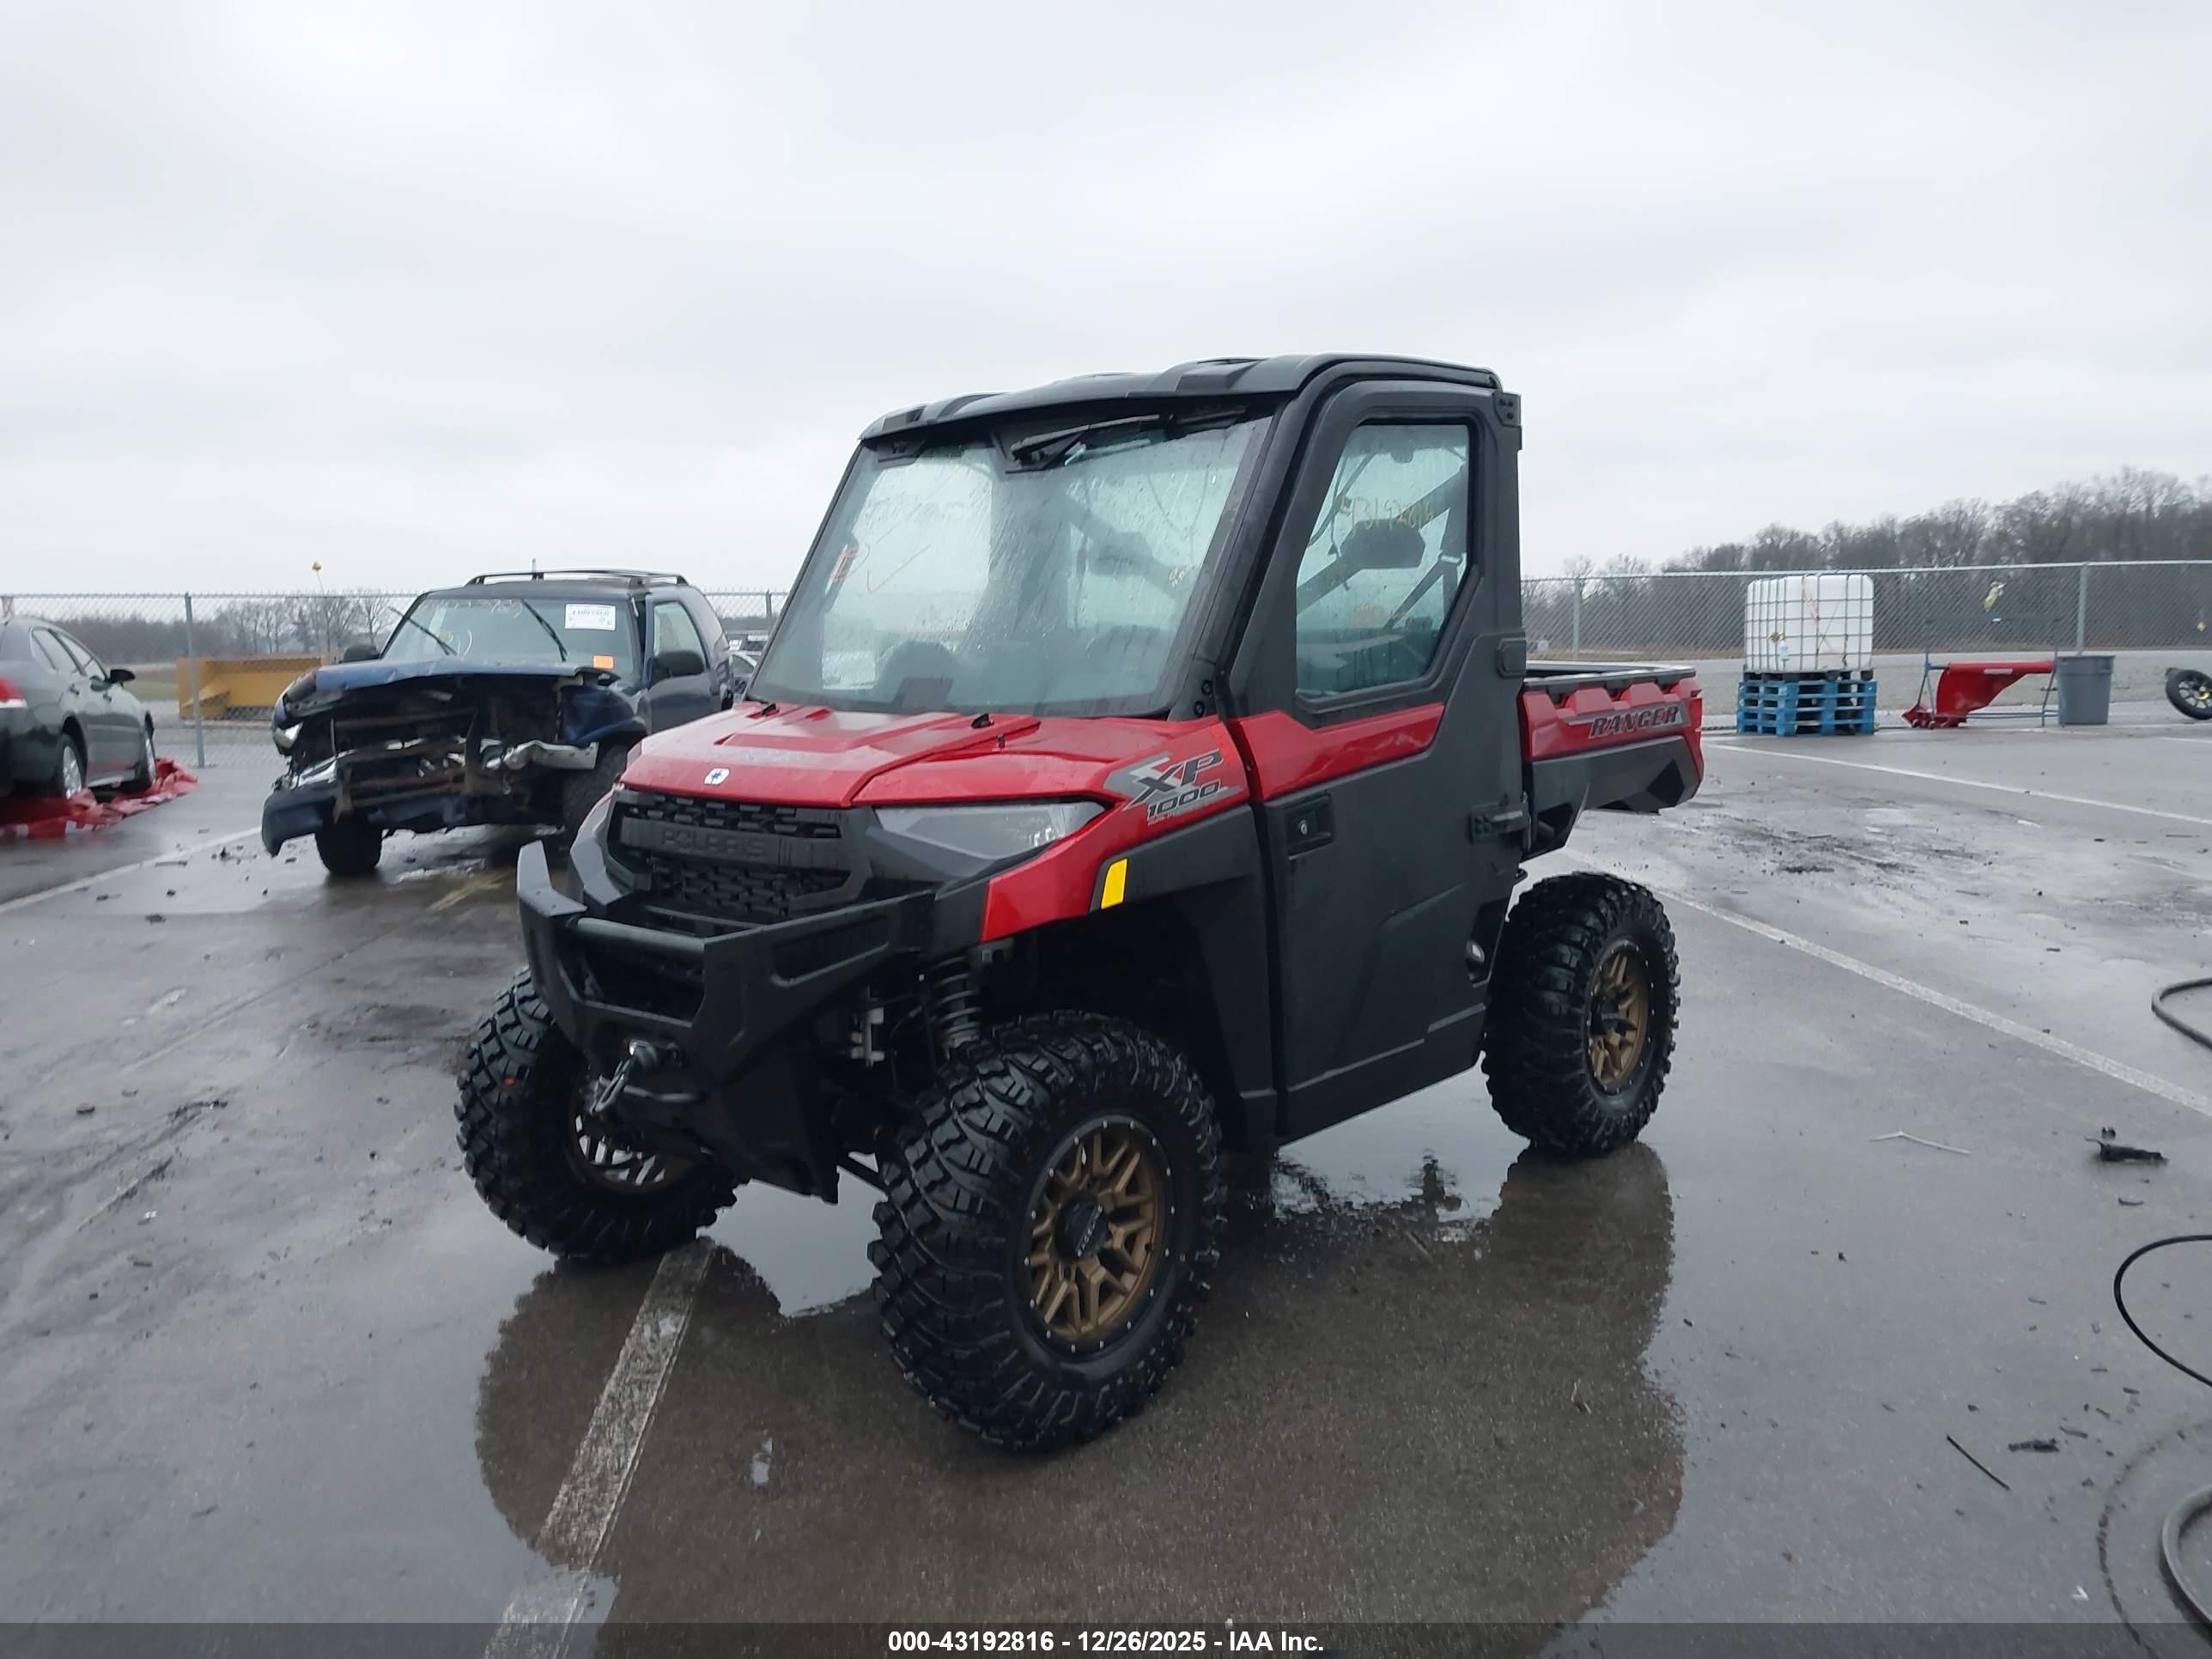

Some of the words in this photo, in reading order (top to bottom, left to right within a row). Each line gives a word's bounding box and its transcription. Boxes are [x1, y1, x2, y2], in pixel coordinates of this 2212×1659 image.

[1589, 706, 1680, 738] RANGER
[1122, 749, 1224, 811] XP
[1147, 779, 1221, 819] 1000
[660, 830, 767, 860] POLARIS
